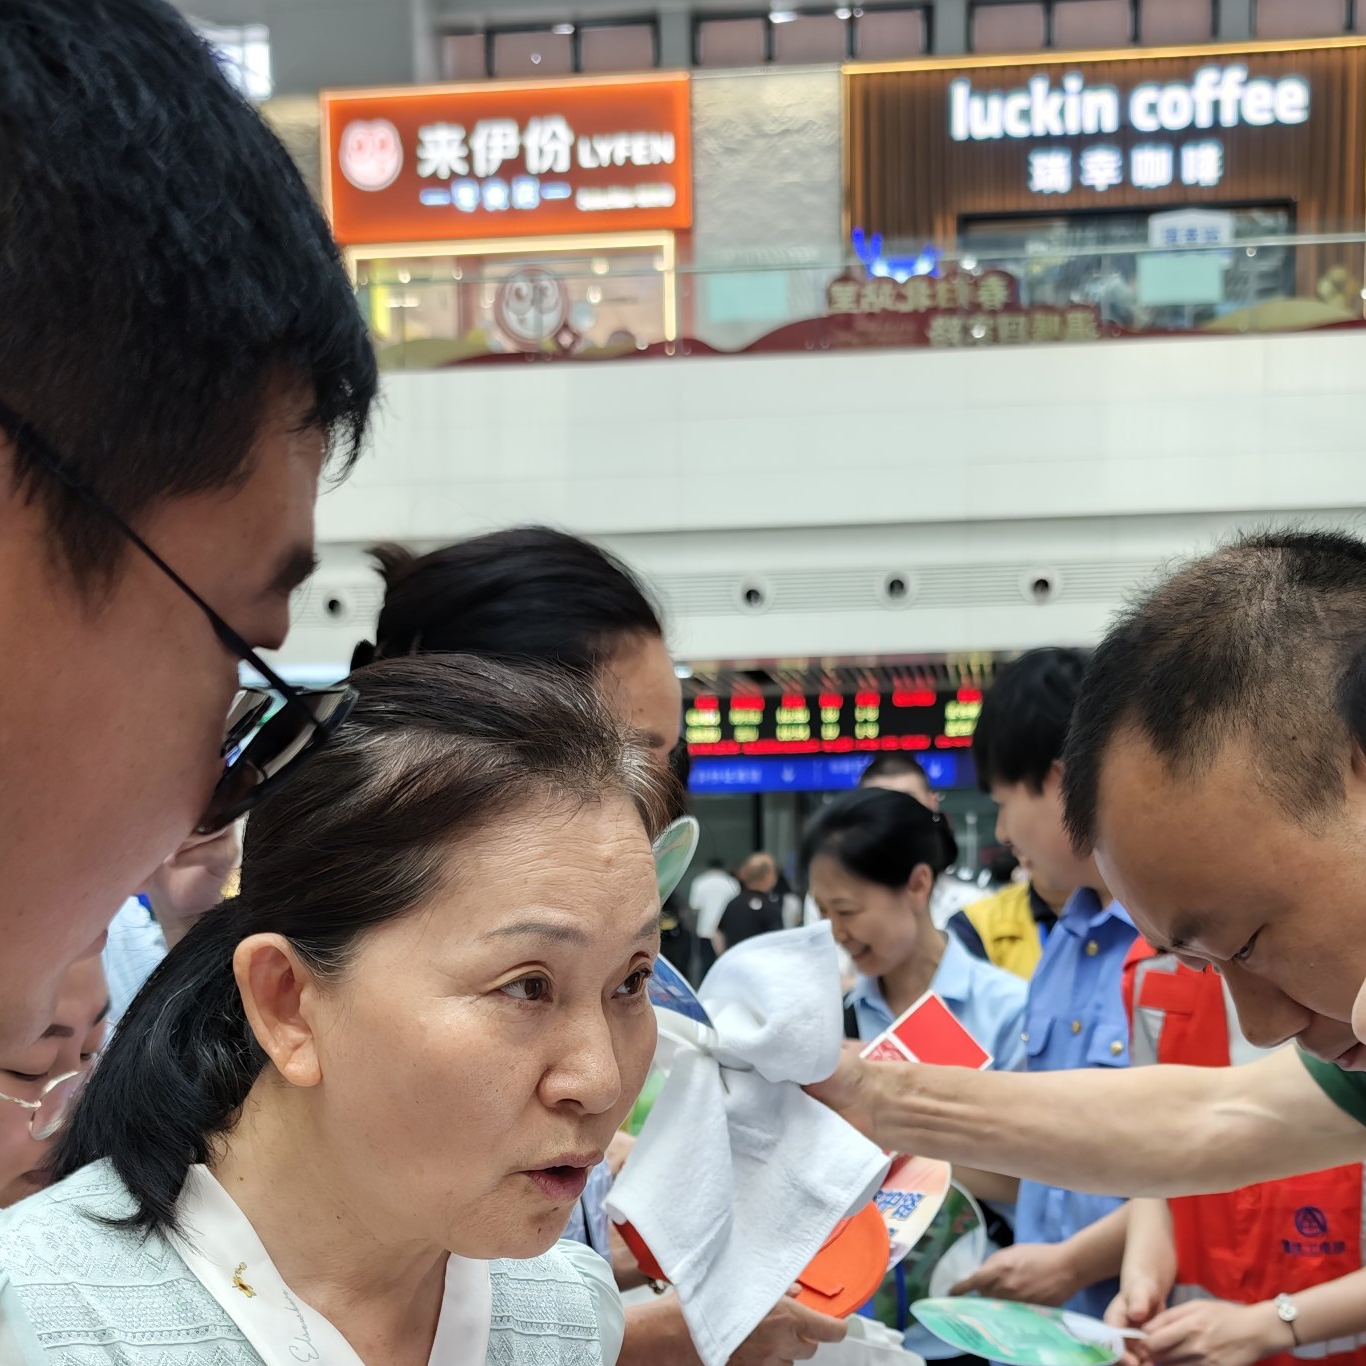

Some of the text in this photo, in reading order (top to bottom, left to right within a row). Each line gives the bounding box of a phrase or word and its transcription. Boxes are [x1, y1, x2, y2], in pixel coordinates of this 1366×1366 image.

[950, 63, 1310, 141] luckin coffee
[416, 114, 574, 179] 来伊份
[577, 131, 676, 168] LYFEN
